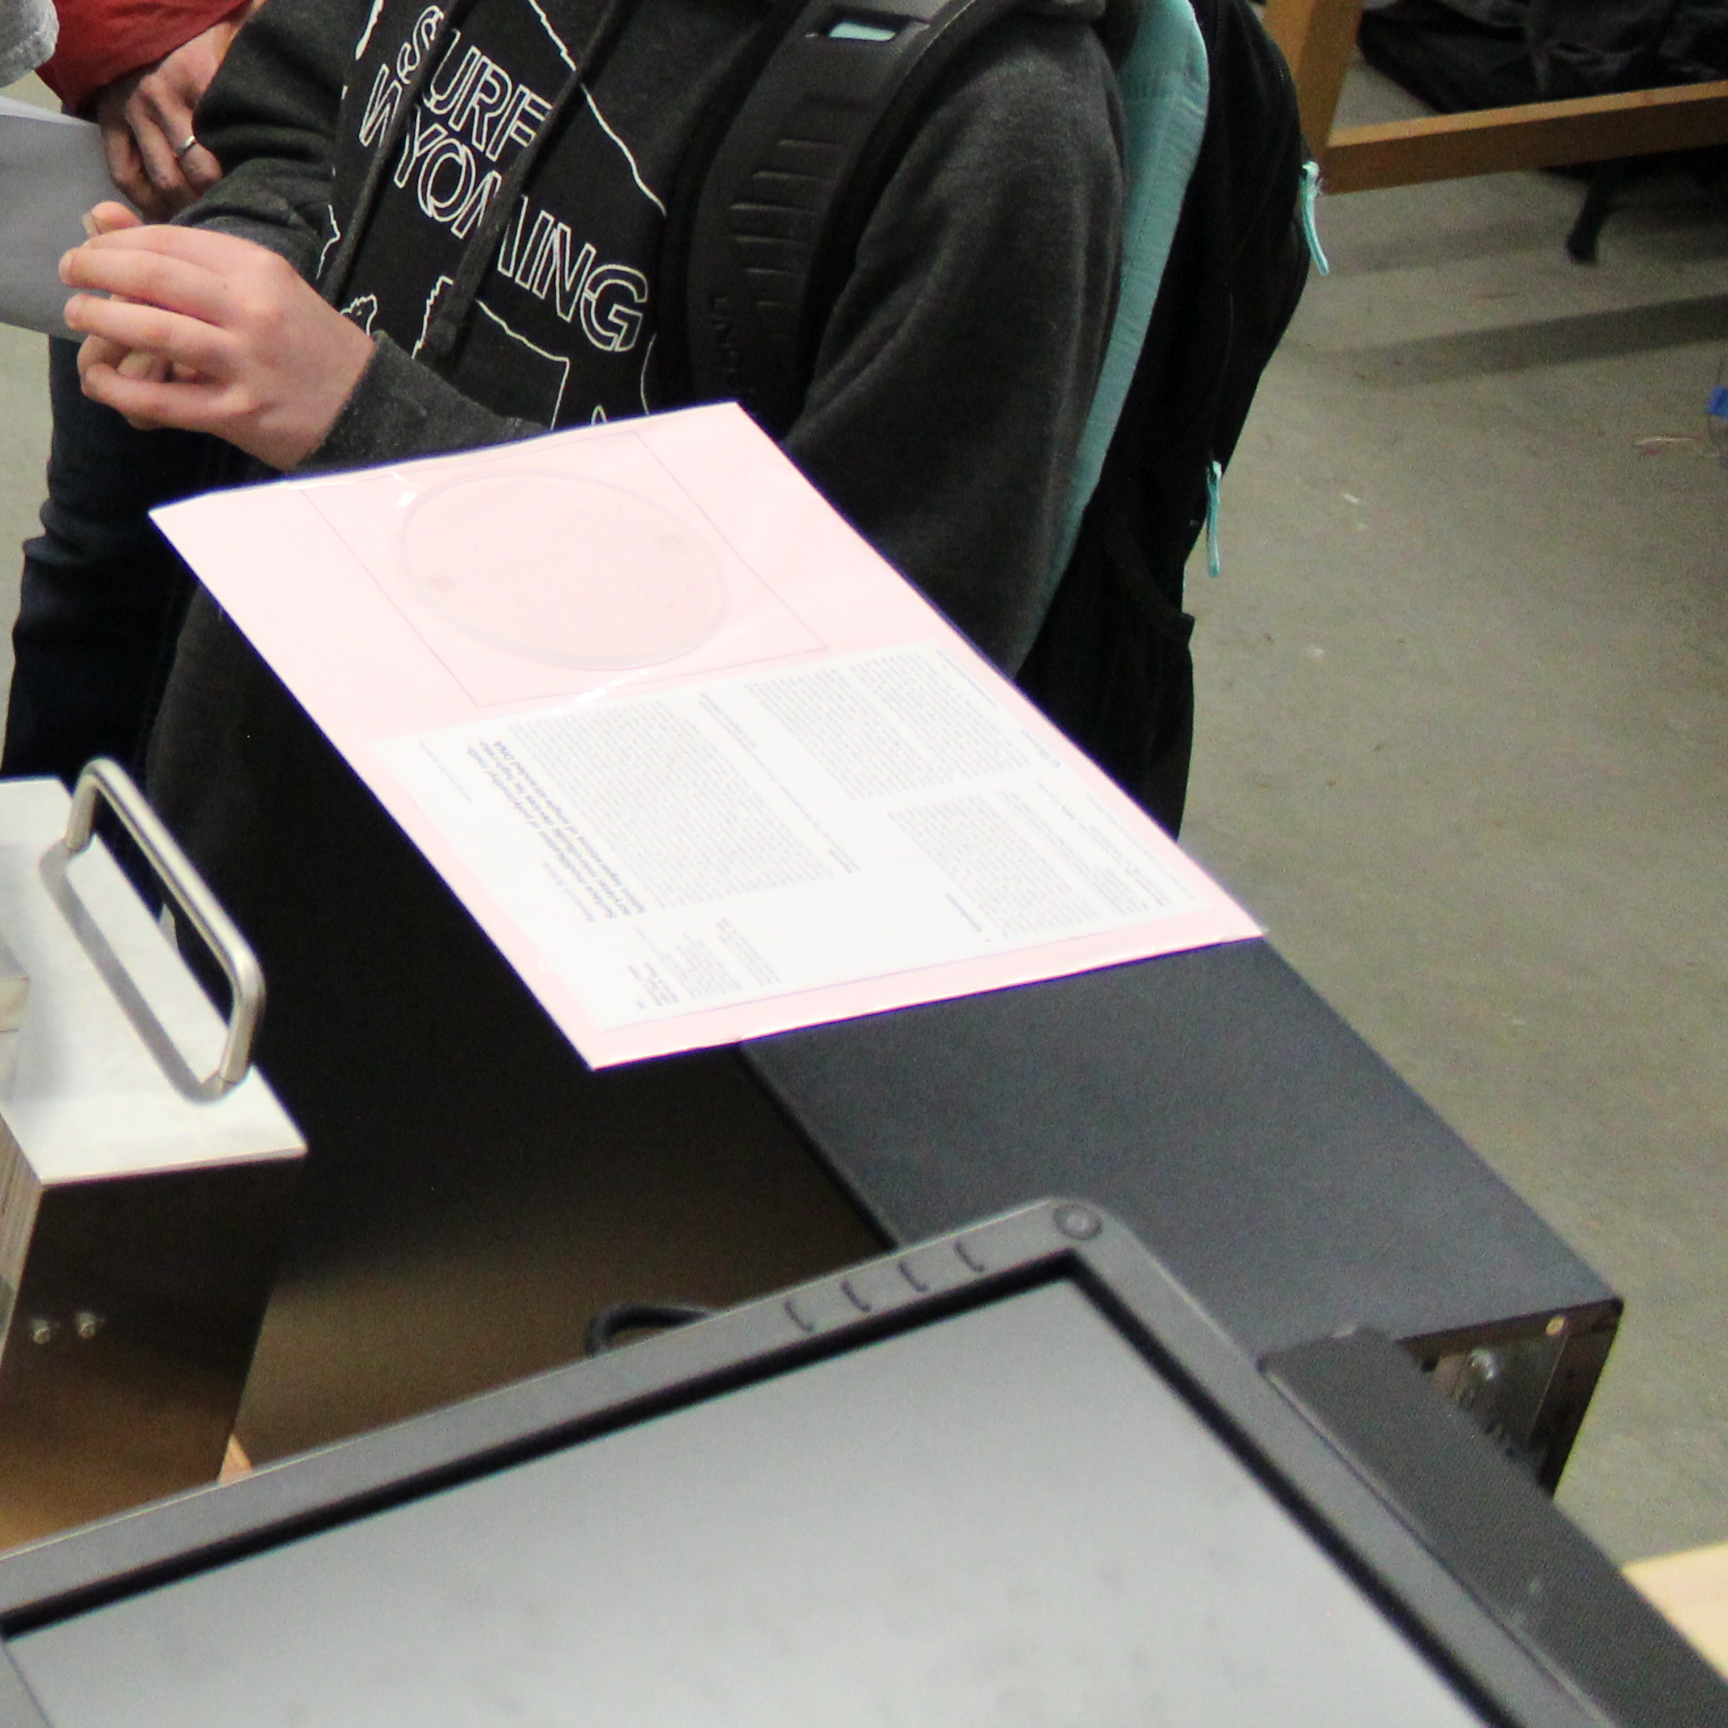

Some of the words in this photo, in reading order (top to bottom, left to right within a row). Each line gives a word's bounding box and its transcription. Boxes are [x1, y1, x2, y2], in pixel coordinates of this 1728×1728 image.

[396, 4, 556, 163] SURF
[489, 739, 517, 761] DNA
[506, 760, 573, 825] single-stranded
[519, 794, 556, 826] devices
[533, 830, 589, 885] modification
[570, 834, 625, 887] separations
